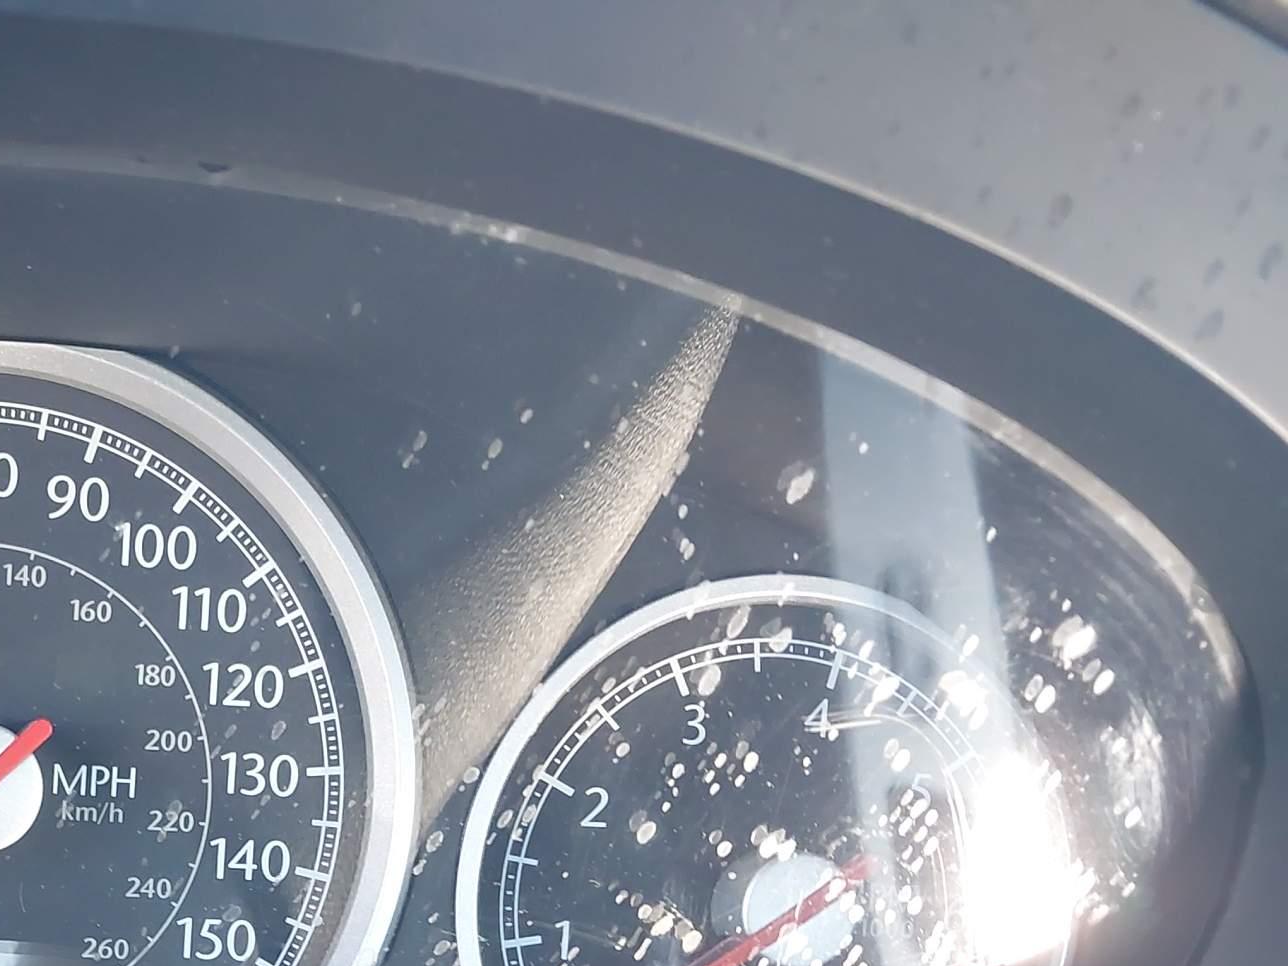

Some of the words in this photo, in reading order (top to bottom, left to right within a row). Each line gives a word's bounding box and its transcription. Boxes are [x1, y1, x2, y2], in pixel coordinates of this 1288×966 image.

[47, 475, 109, 522] 90
[117, 522, 197, 570] 100
[3, 563, 46, 588] 140
[71, 599, 111, 623] 160
[172, 586, 247, 633] 110
[135, 664, 175, 687] 180
[203, 662, 283, 709] 120
[682, 705, 706, 746] 3
[803, 699, 831, 737] 4
[145, 729, 192, 752] 200
[52, 763, 136, 798] MPH
[220, 752, 298, 797] 130
[61, 800, 123, 823] km/h
[147, 810, 194, 833] 220
[581, 787, 608, 828] 2
[210, 838, 290, 882] 140
[125, 877, 171, 899] 240
[82, 938, 129, 960] 260
[177, 918, 255, 962] 150
[555, 921, 570, 961] 1
